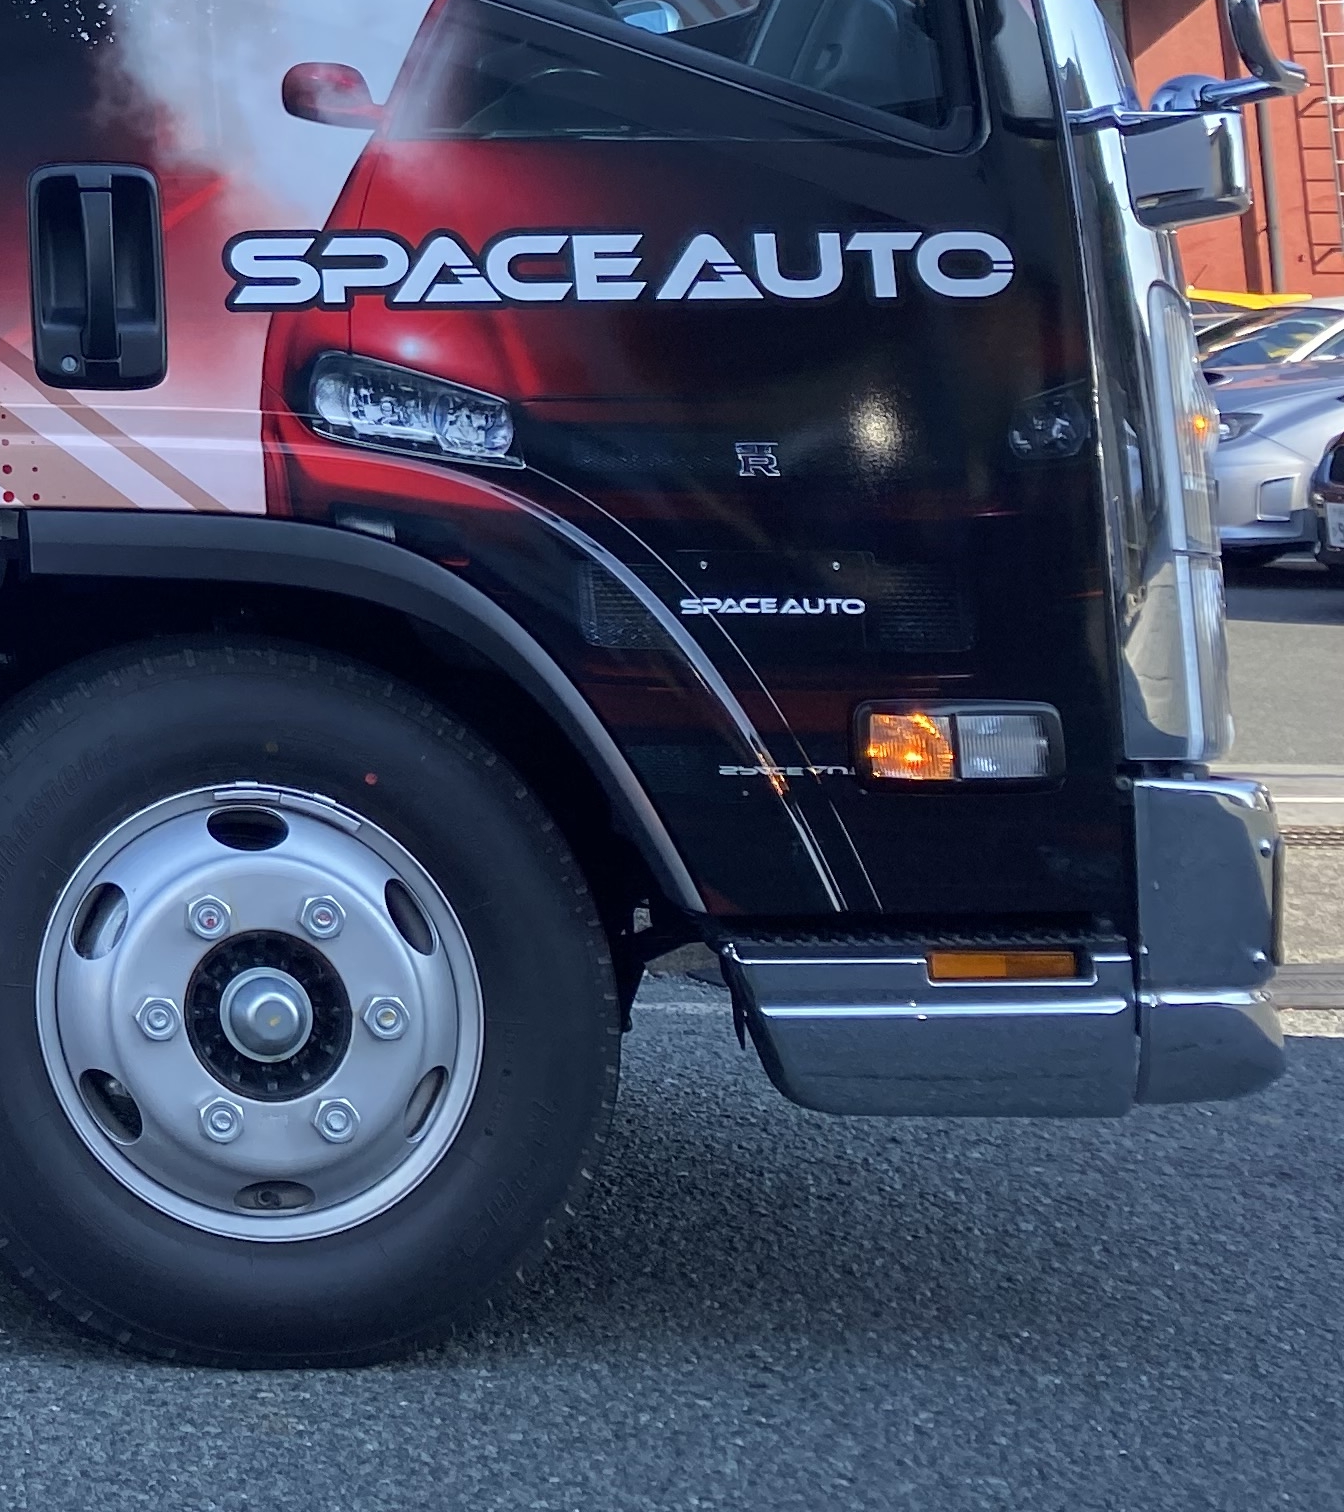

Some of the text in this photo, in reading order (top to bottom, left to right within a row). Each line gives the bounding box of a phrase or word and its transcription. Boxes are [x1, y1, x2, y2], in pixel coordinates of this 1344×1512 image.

[228, 230, 1015, 305] SPACE AUTO
[679, 597, 866, 615] SPACE AUTO
